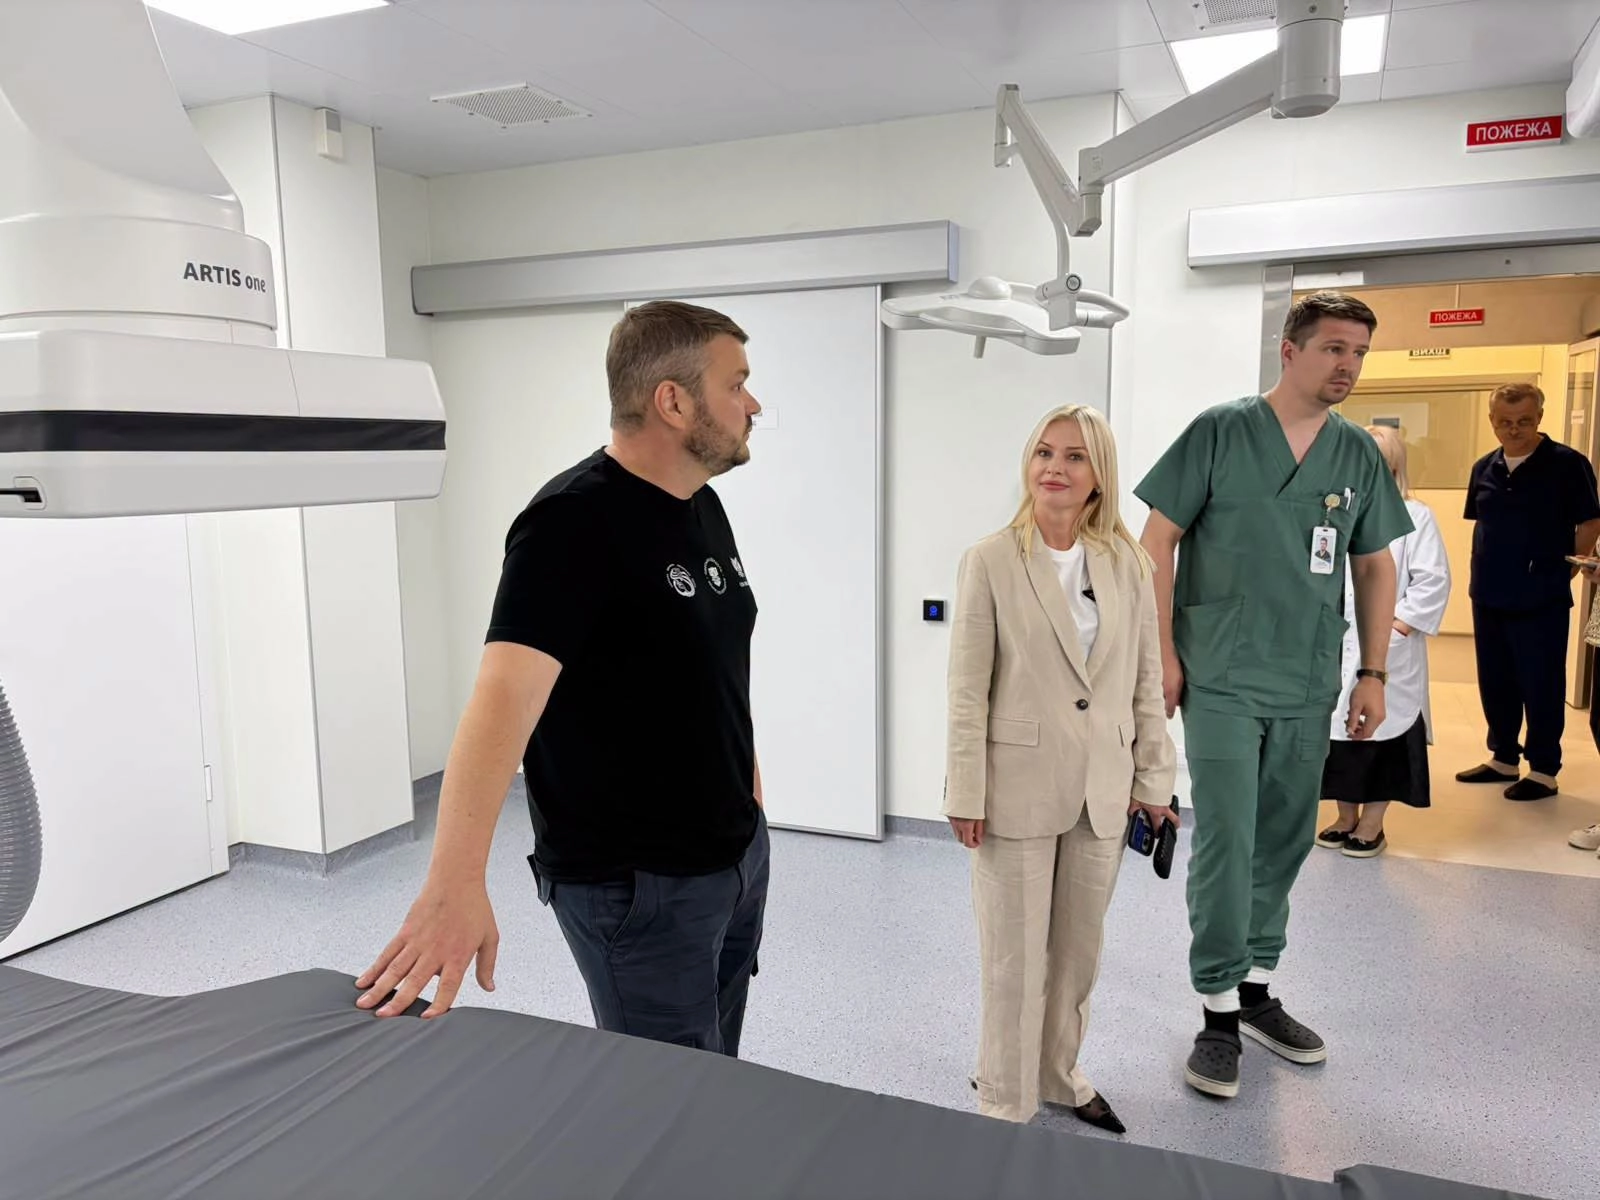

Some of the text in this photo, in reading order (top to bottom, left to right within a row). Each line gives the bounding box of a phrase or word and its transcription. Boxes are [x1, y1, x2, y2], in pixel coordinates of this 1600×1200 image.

[1475, 121, 1552, 142] ПОЖЕЖА
[183, 262, 266, 293] ARTIS one
[1434, 311, 1478, 322] ПОЖЕЖА
